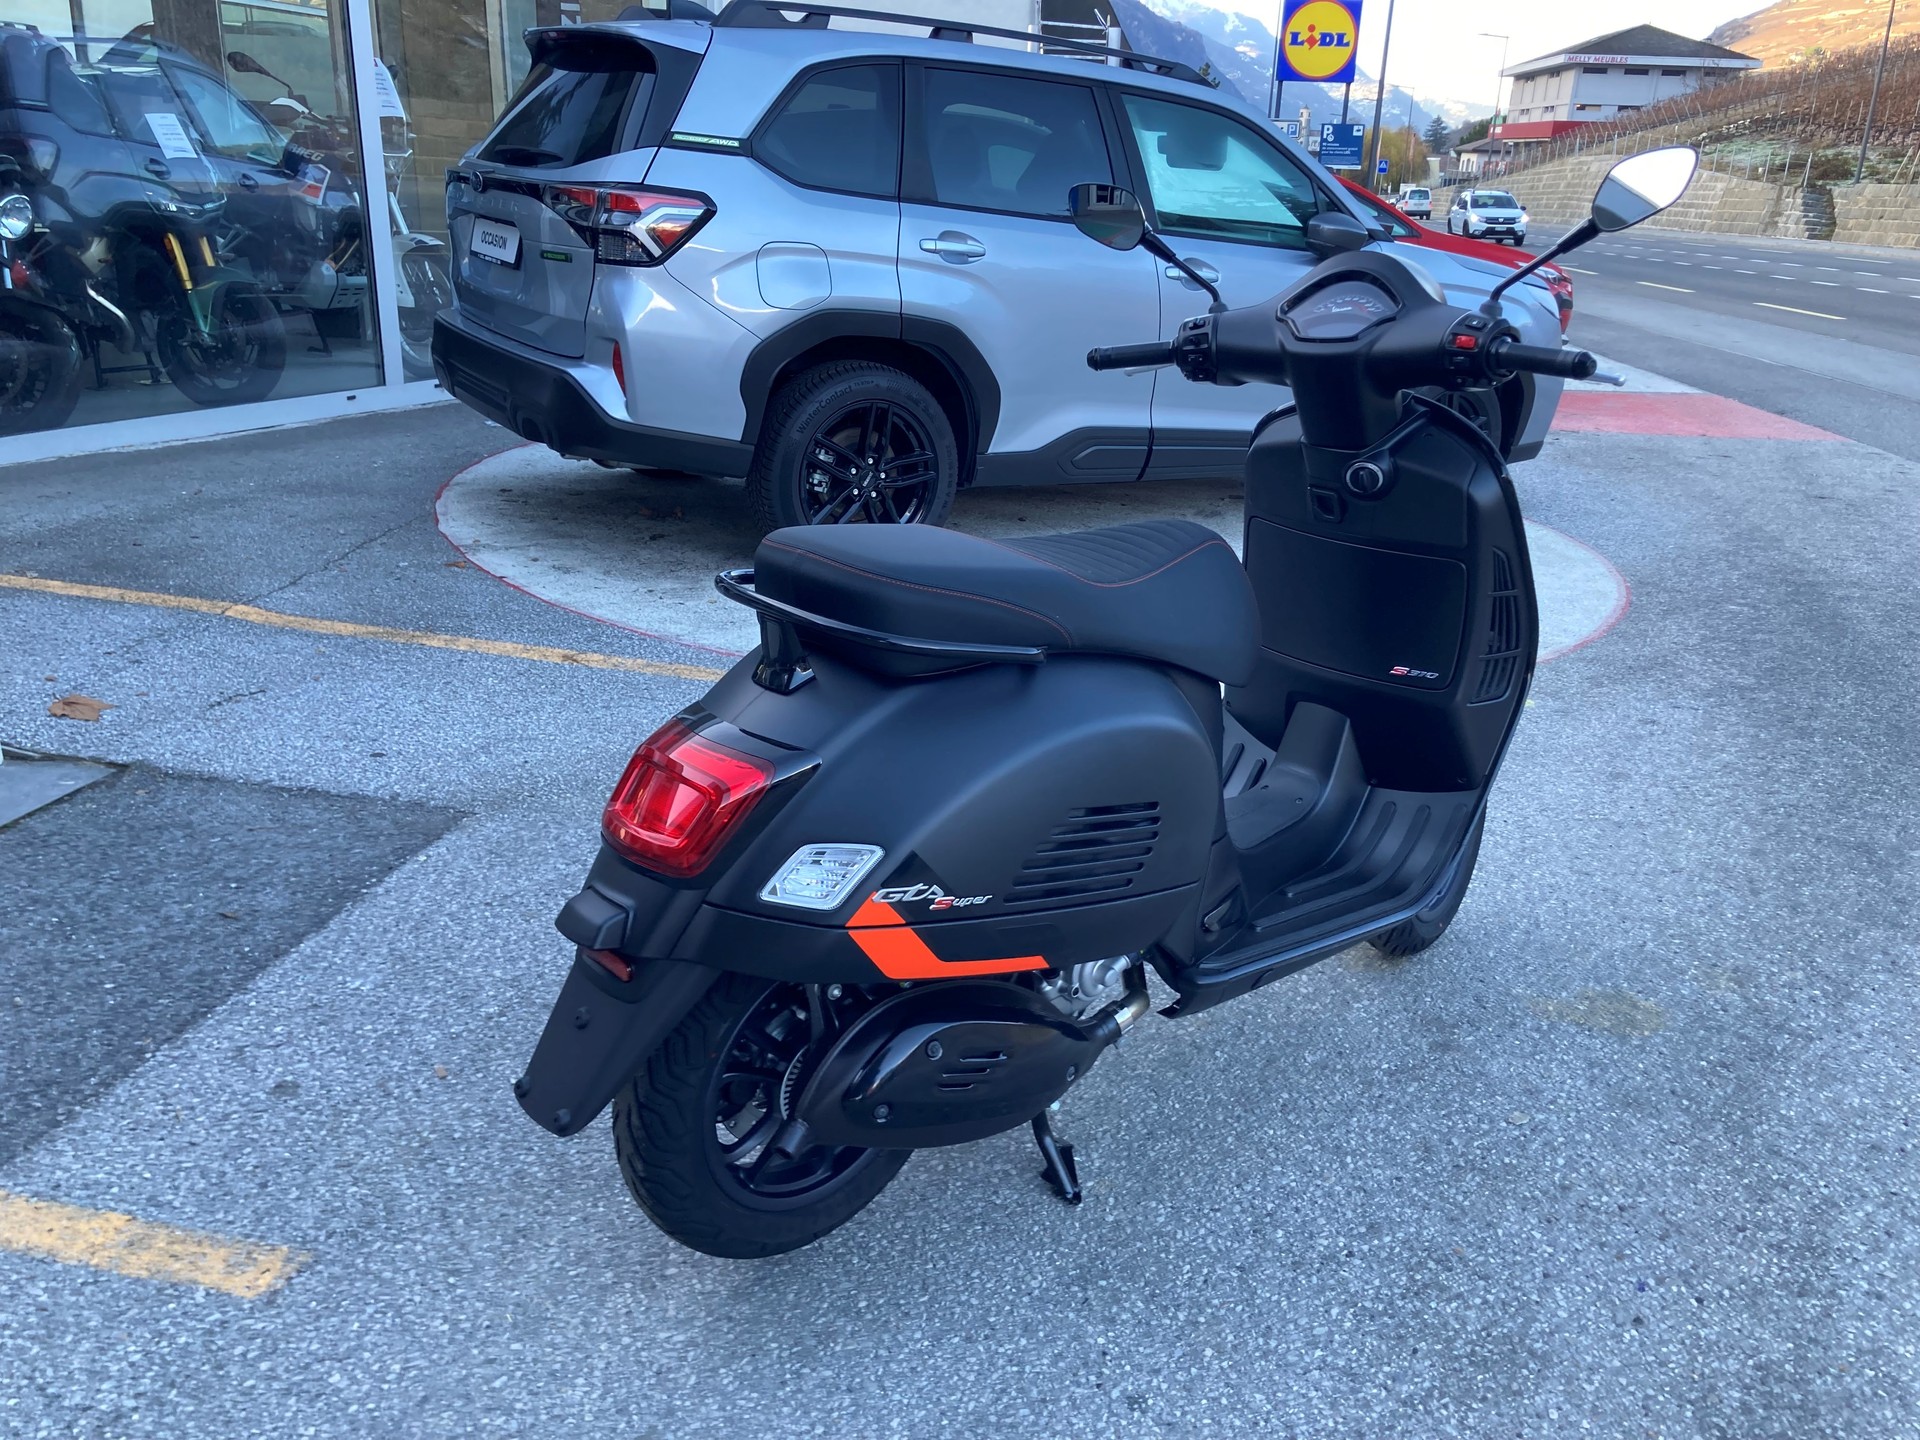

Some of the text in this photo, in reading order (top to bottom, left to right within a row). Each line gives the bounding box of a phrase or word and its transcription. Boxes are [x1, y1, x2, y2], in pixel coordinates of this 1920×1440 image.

[1566, 55, 1629, 64] MELLY MEUBLES
[1323, 125, 1333, 139] P
[480, 230, 508, 251] OCCASION
[796, 384, 853, 435] WinterContact
